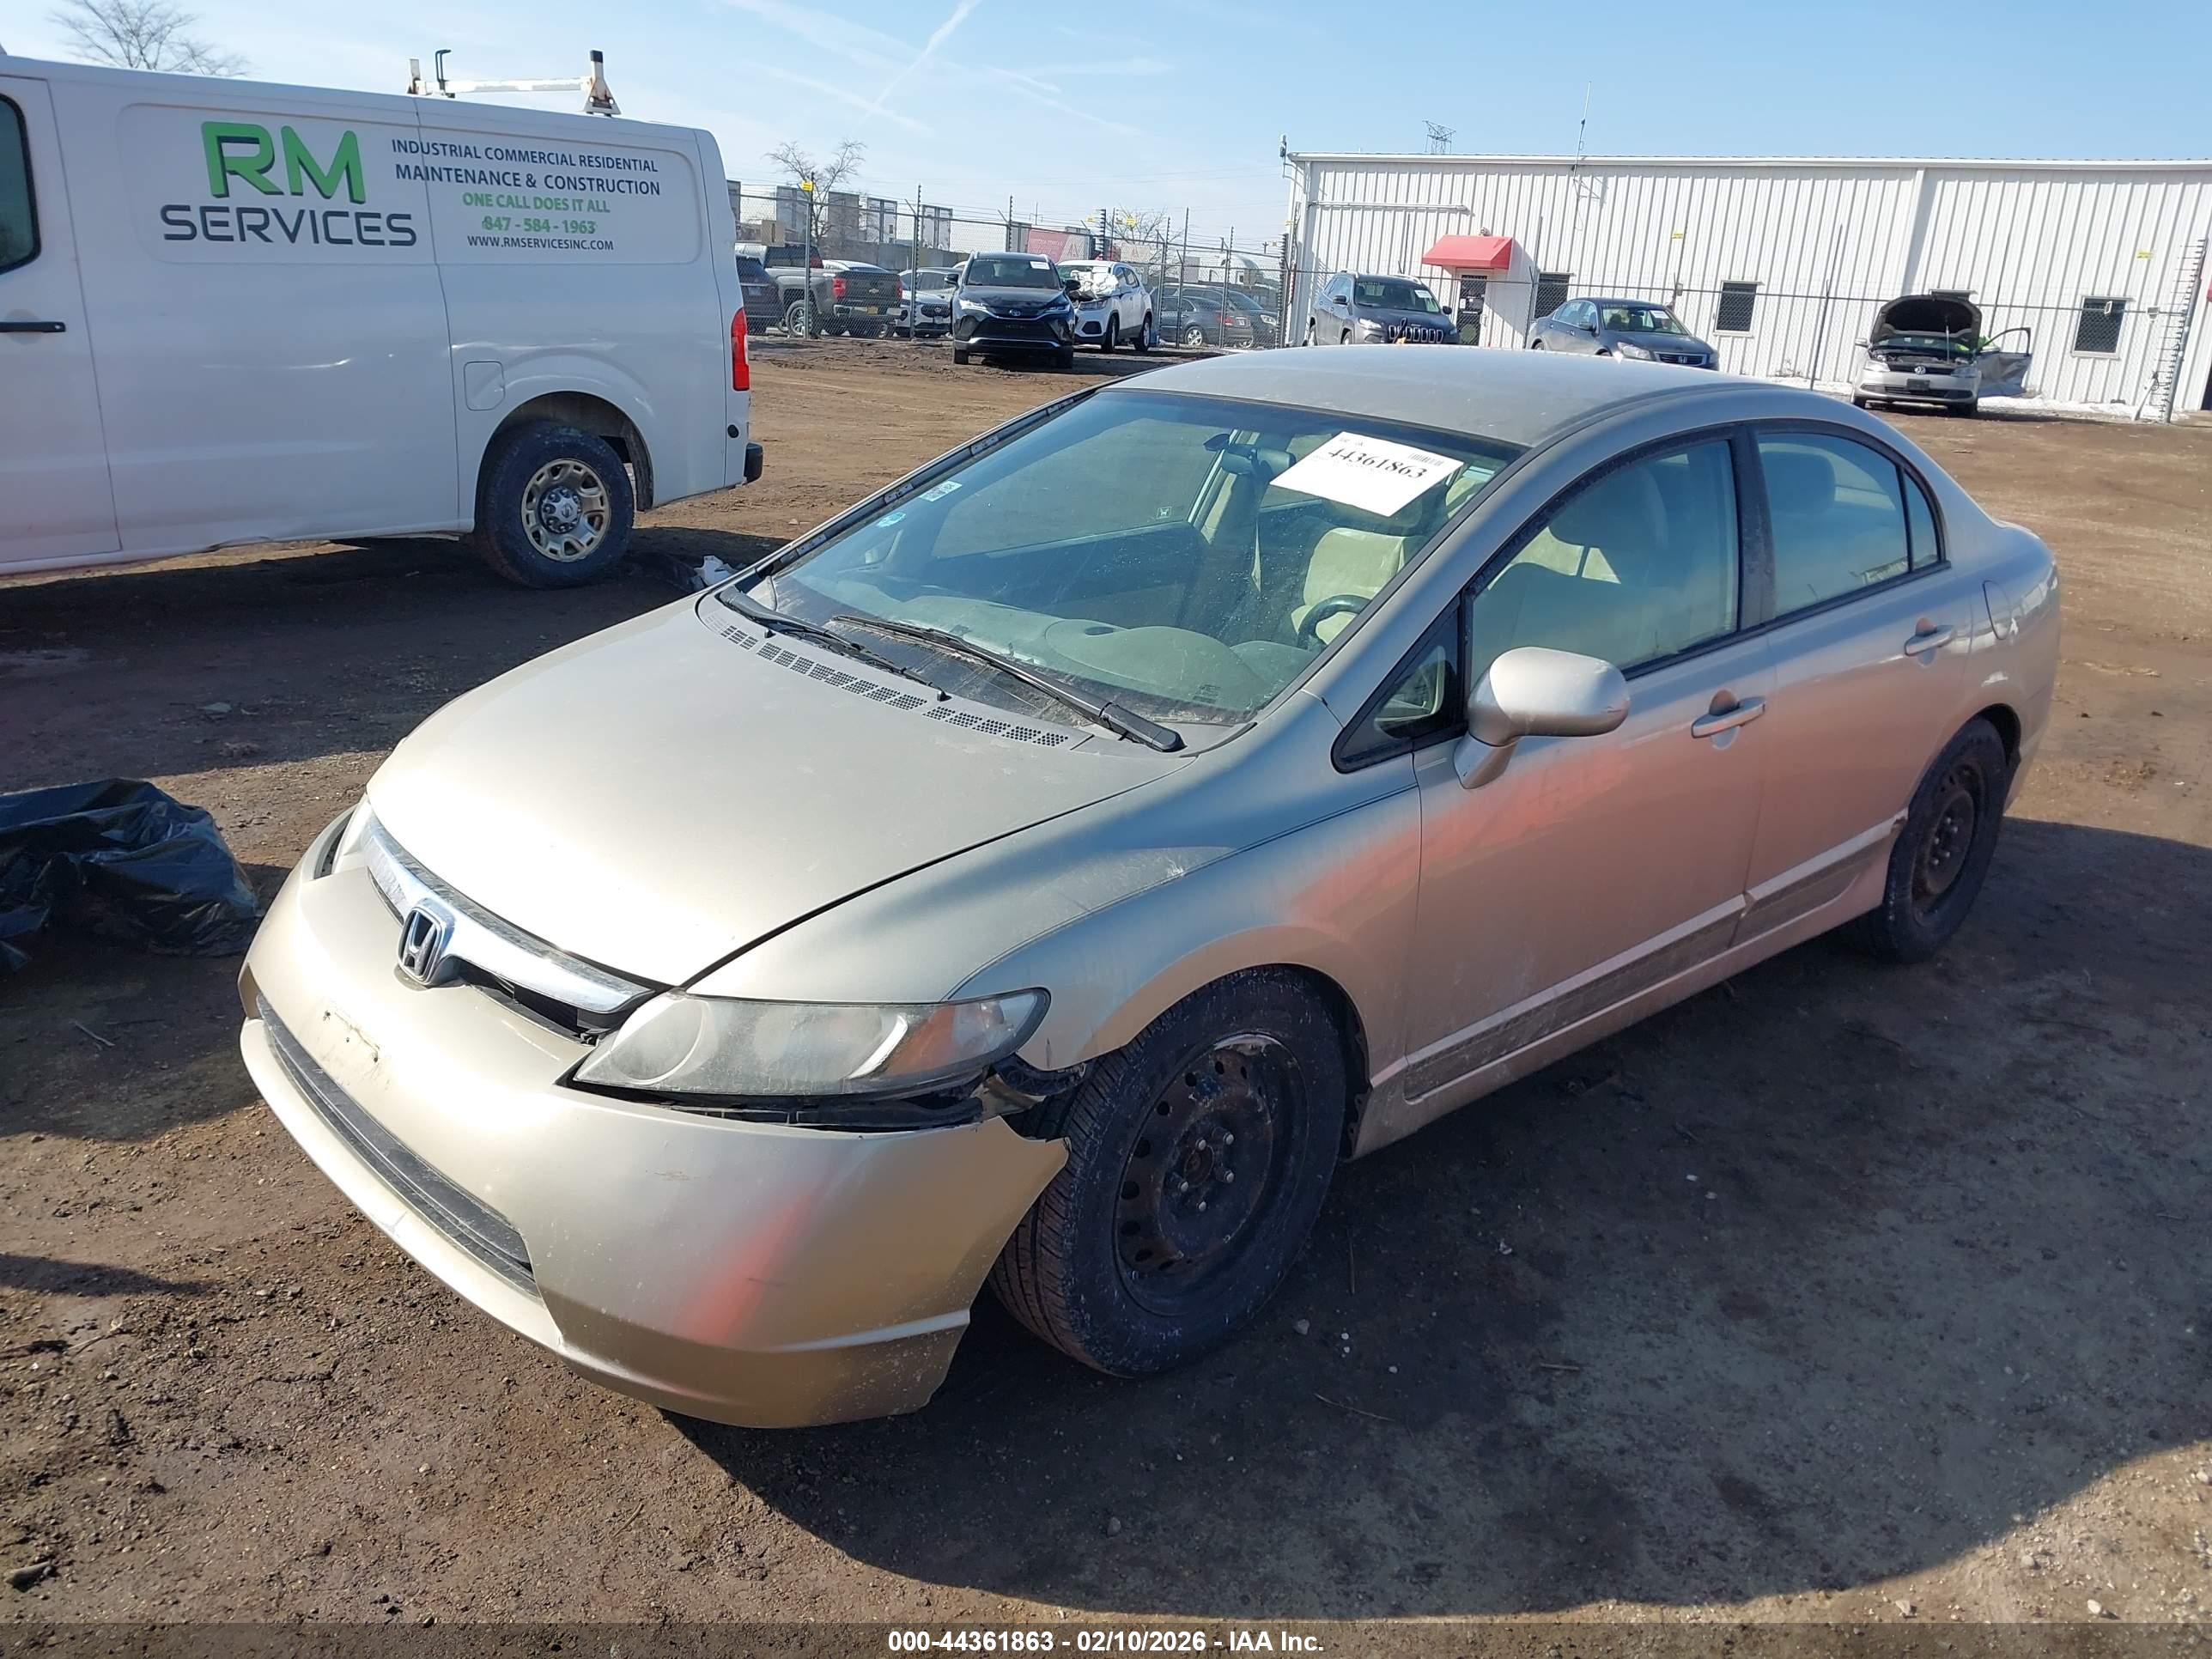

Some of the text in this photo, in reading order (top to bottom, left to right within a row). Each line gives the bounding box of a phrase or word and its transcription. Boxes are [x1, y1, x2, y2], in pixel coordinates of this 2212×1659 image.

[201, 121, 366, 205] RM
[392, 139, 659, 173] INDUSTRIAL COMMERCIAL RESIDENTIAL
[395, 164, 661, 196] MAINTENANCE & CONSTRUCTION
[462, 191, 611, 214] ONE CALL DOES IT ALL
[160, 204, 417, 246] SERVICES
[482, 216, 511, 231] 847
[523, 218, 550, 233] 584
[561, 219, 597, 234] 1963
[467, 235, 614, 251] WWW.RMSERVICESINC.COM
[1328, 448, 1428, 478] 44361863
